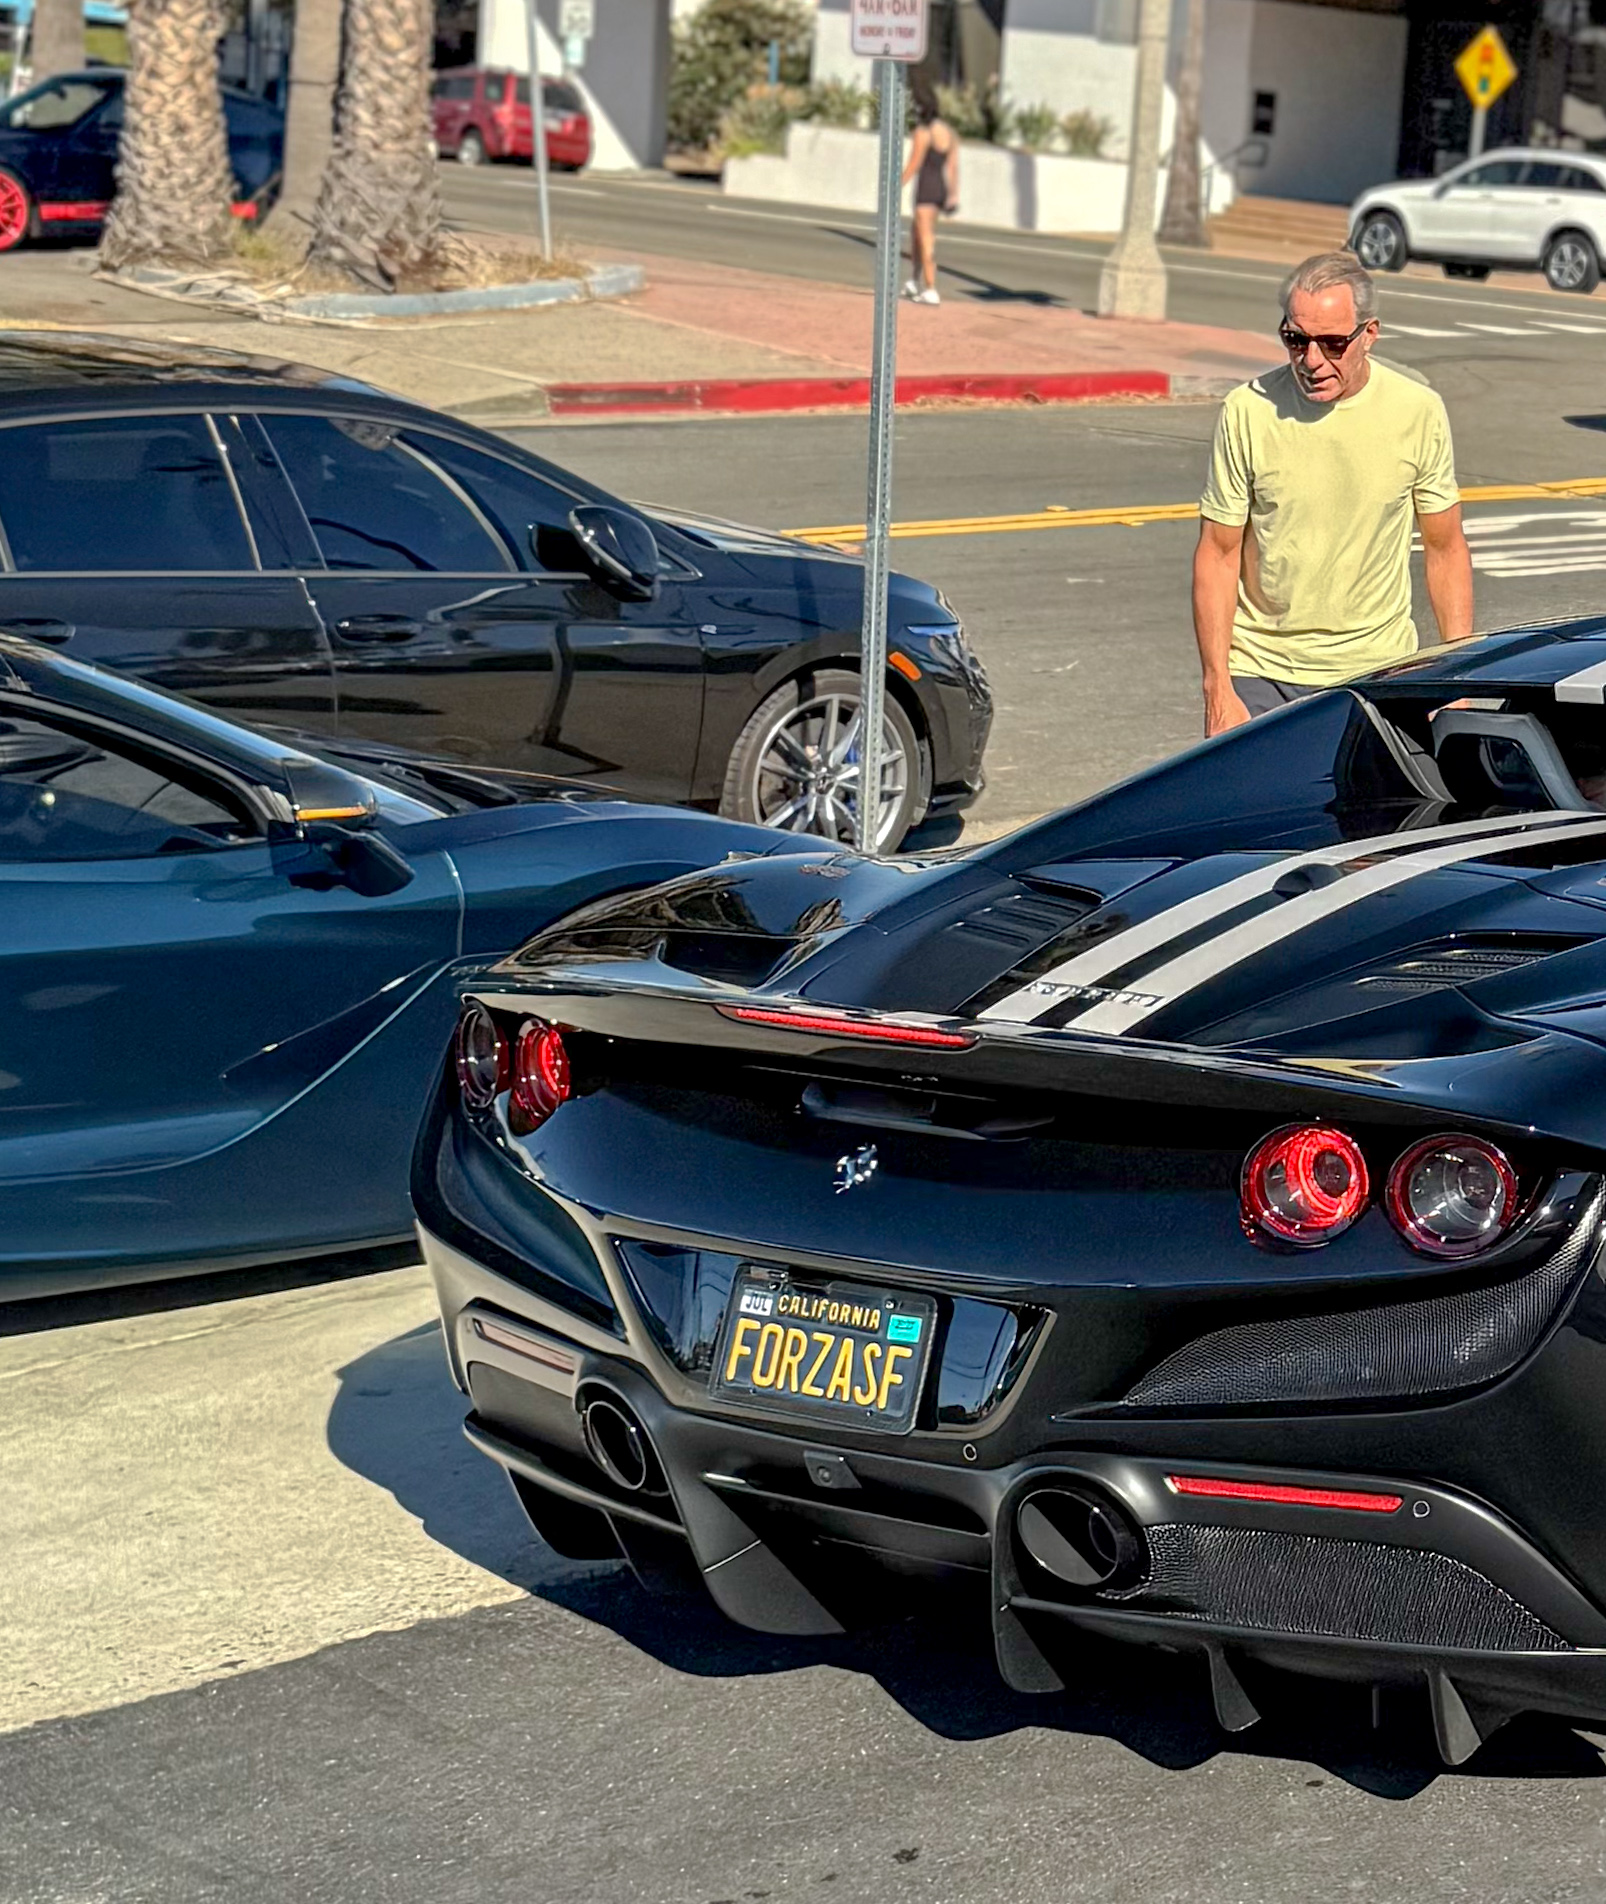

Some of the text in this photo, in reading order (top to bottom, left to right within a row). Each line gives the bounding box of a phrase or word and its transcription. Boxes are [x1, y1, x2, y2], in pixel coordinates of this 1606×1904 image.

[744, 1297, 769, 1313] JUL
[777, 1294, 882, 1331] CALIFORNIA
[725, 1317, 914, 1411] FORZASF
